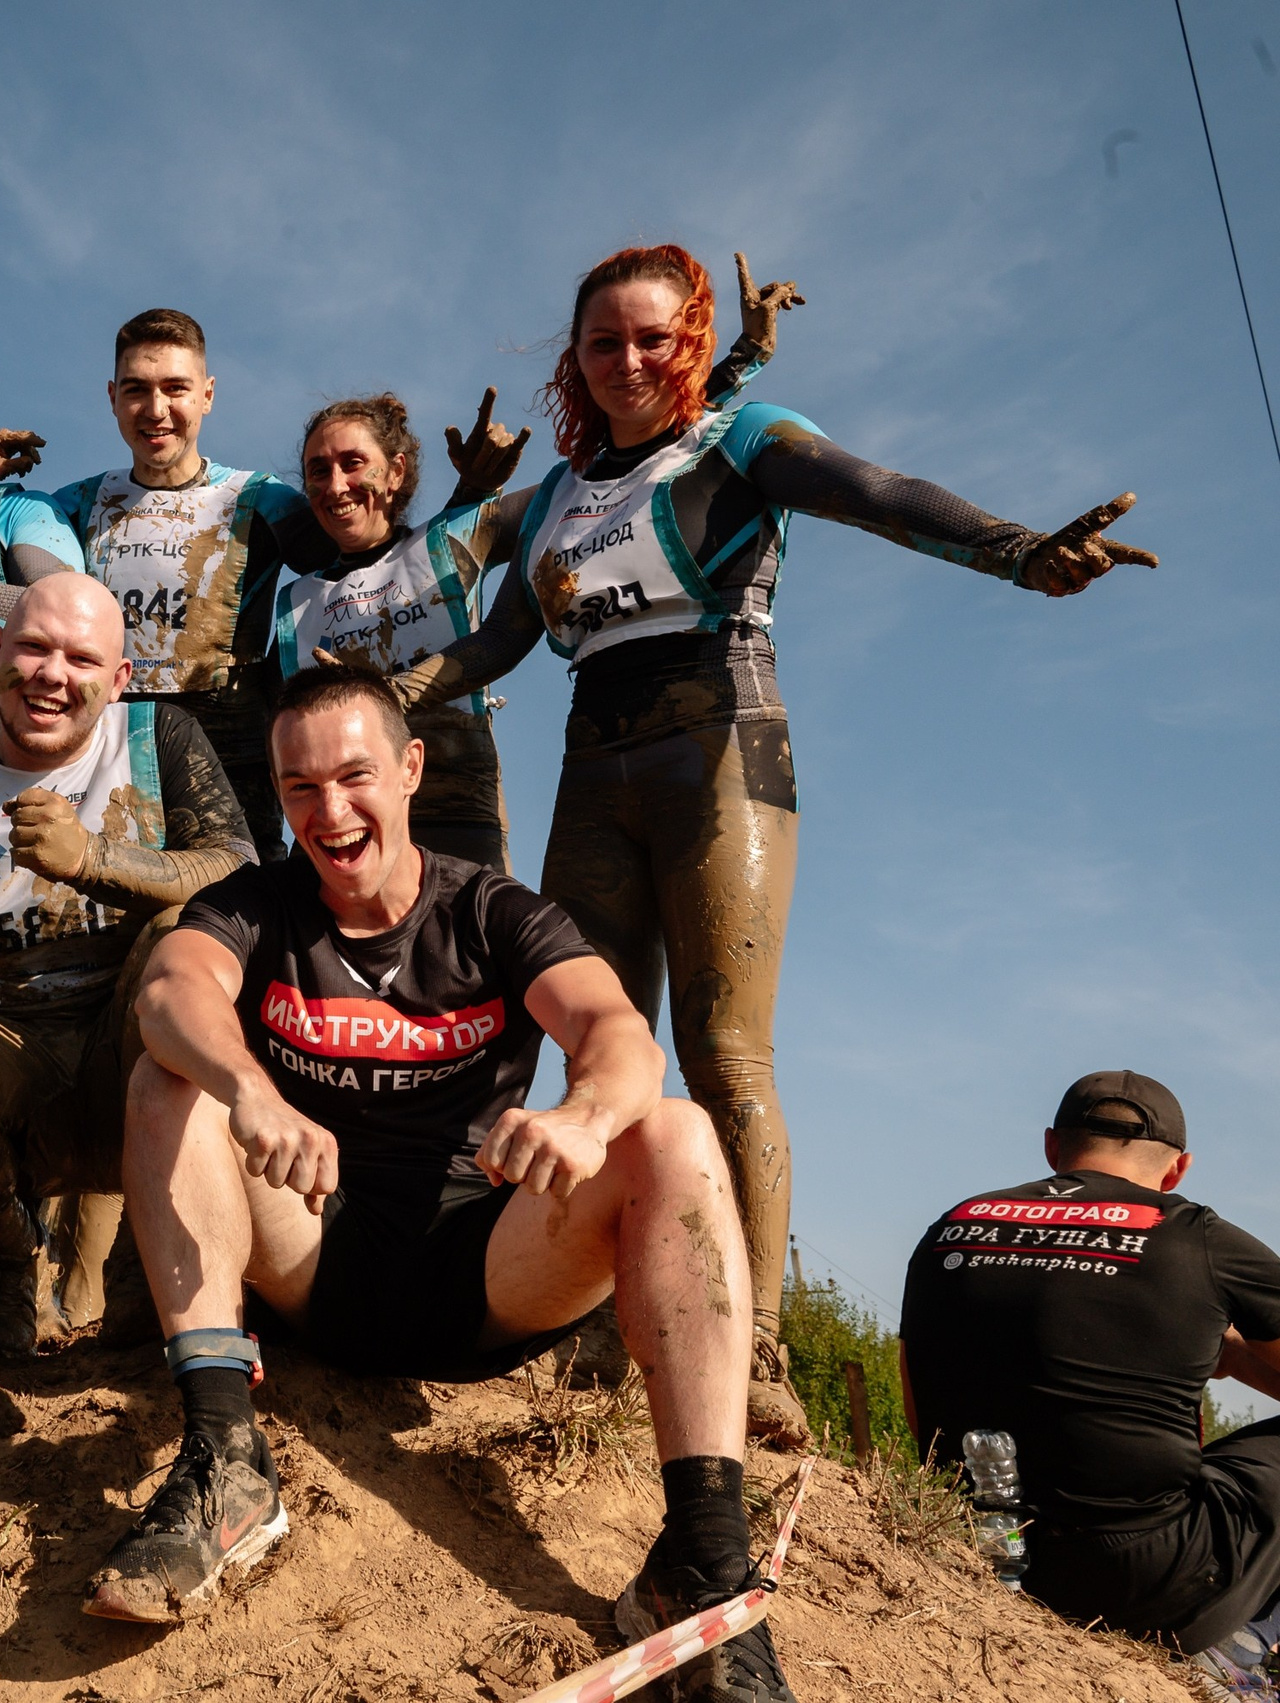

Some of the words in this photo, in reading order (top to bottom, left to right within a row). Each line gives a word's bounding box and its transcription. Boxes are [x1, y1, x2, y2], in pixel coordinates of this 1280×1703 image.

[564, 505, 592, 518] ОНКА
[118, 543, 193, 559] РТК-ЦО
[553, 522, 635, 569] РТК-ЦОД
[111, 587, 190, 630] 842
[324, 594, 356, 613] ГОНКА
[357, 579, 395, 600] ГЕРОЕВ
[333, 602, 428, 649] РТК-ОД
[267, 994, 495, 1052] ИНСТРУКТОР
[269, 1037, 361, 1091] ГОНКА
[372, 1049, 487, 1092] ГЕРОЕВ
[968, 1202, 1130, 1223] ФОТОГРАФ
[936, 1225, 1000, 1244] ЮРА
[1011, 1227, 1149, 1254] ГУШАН
[968, 1254, 1118, 1276] gushanphoto
